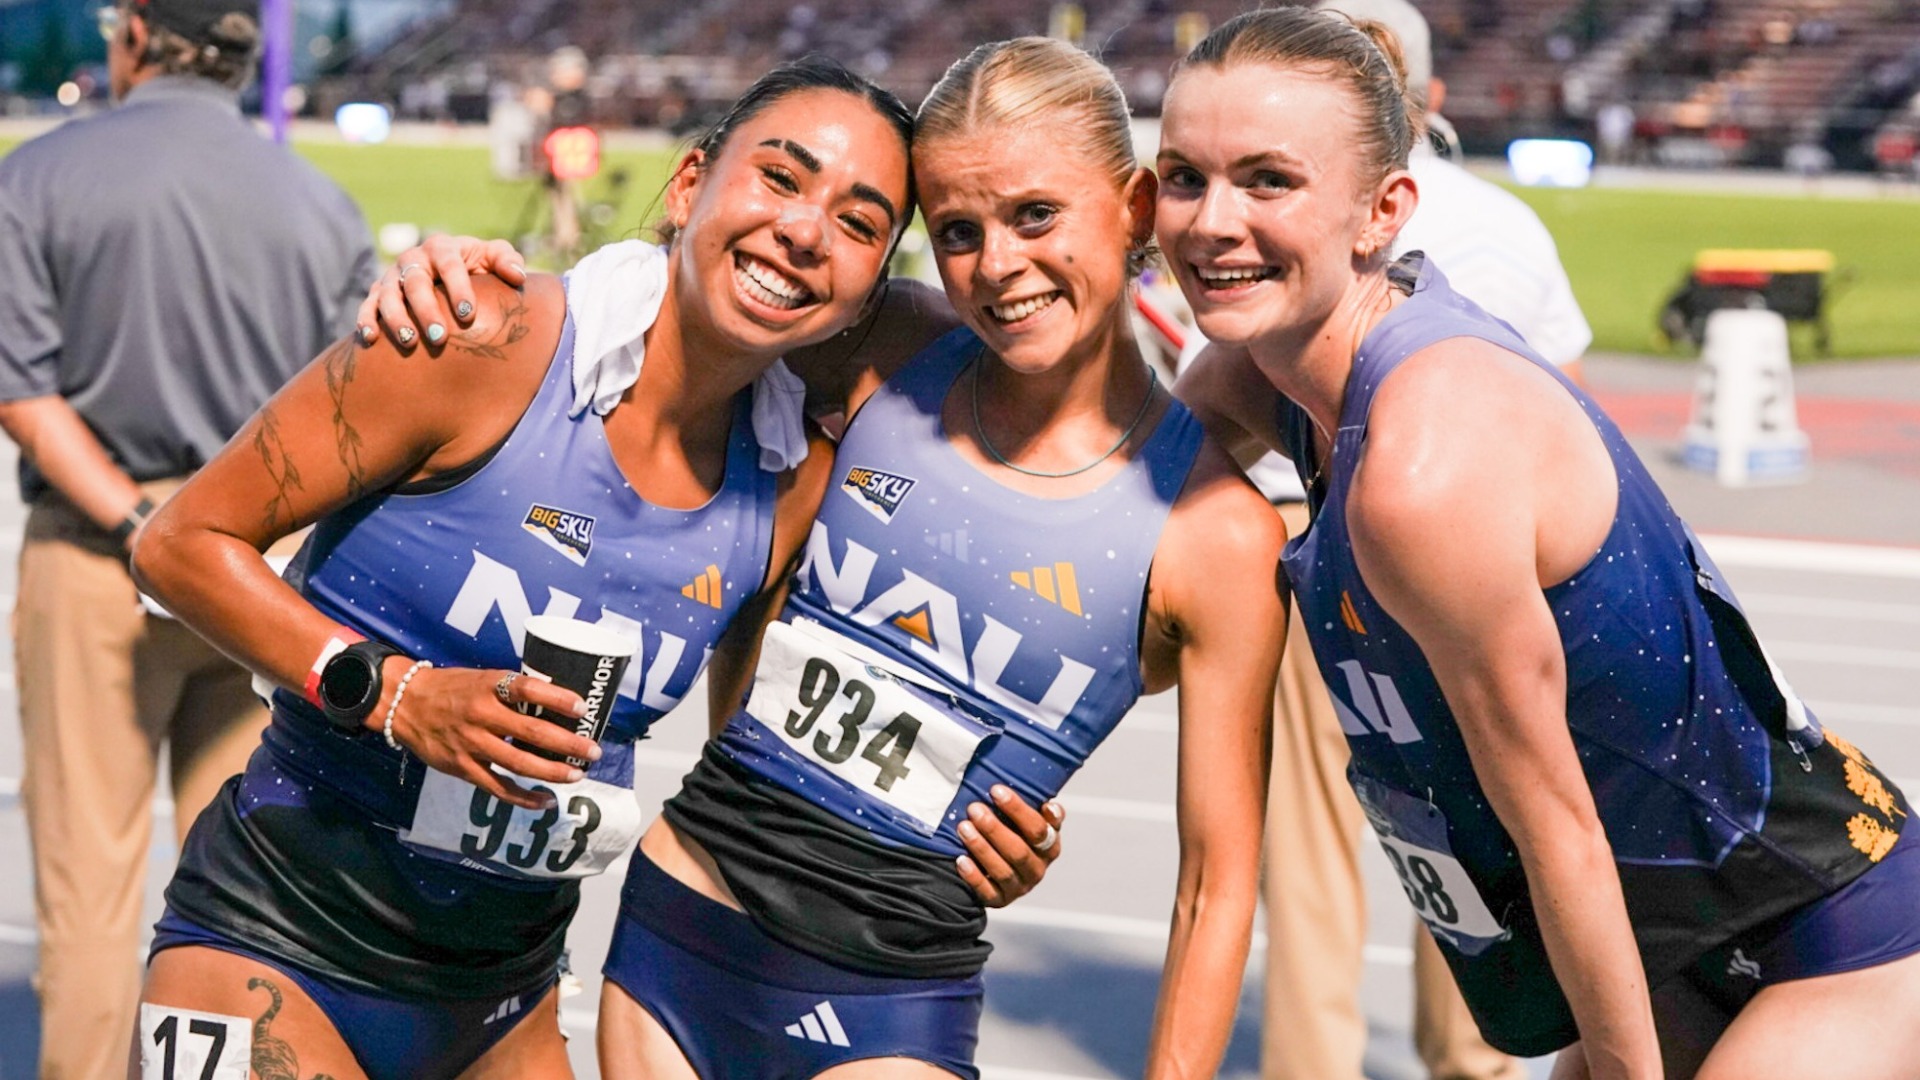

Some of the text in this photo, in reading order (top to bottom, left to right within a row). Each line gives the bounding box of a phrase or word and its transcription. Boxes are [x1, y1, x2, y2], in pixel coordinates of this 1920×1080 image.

[797, 519, 1096, 730] NAU
[784, 657, 922, 793] 934
[460, 776, 602, 872] 933
[153, 1015, 227, 1080] 17
